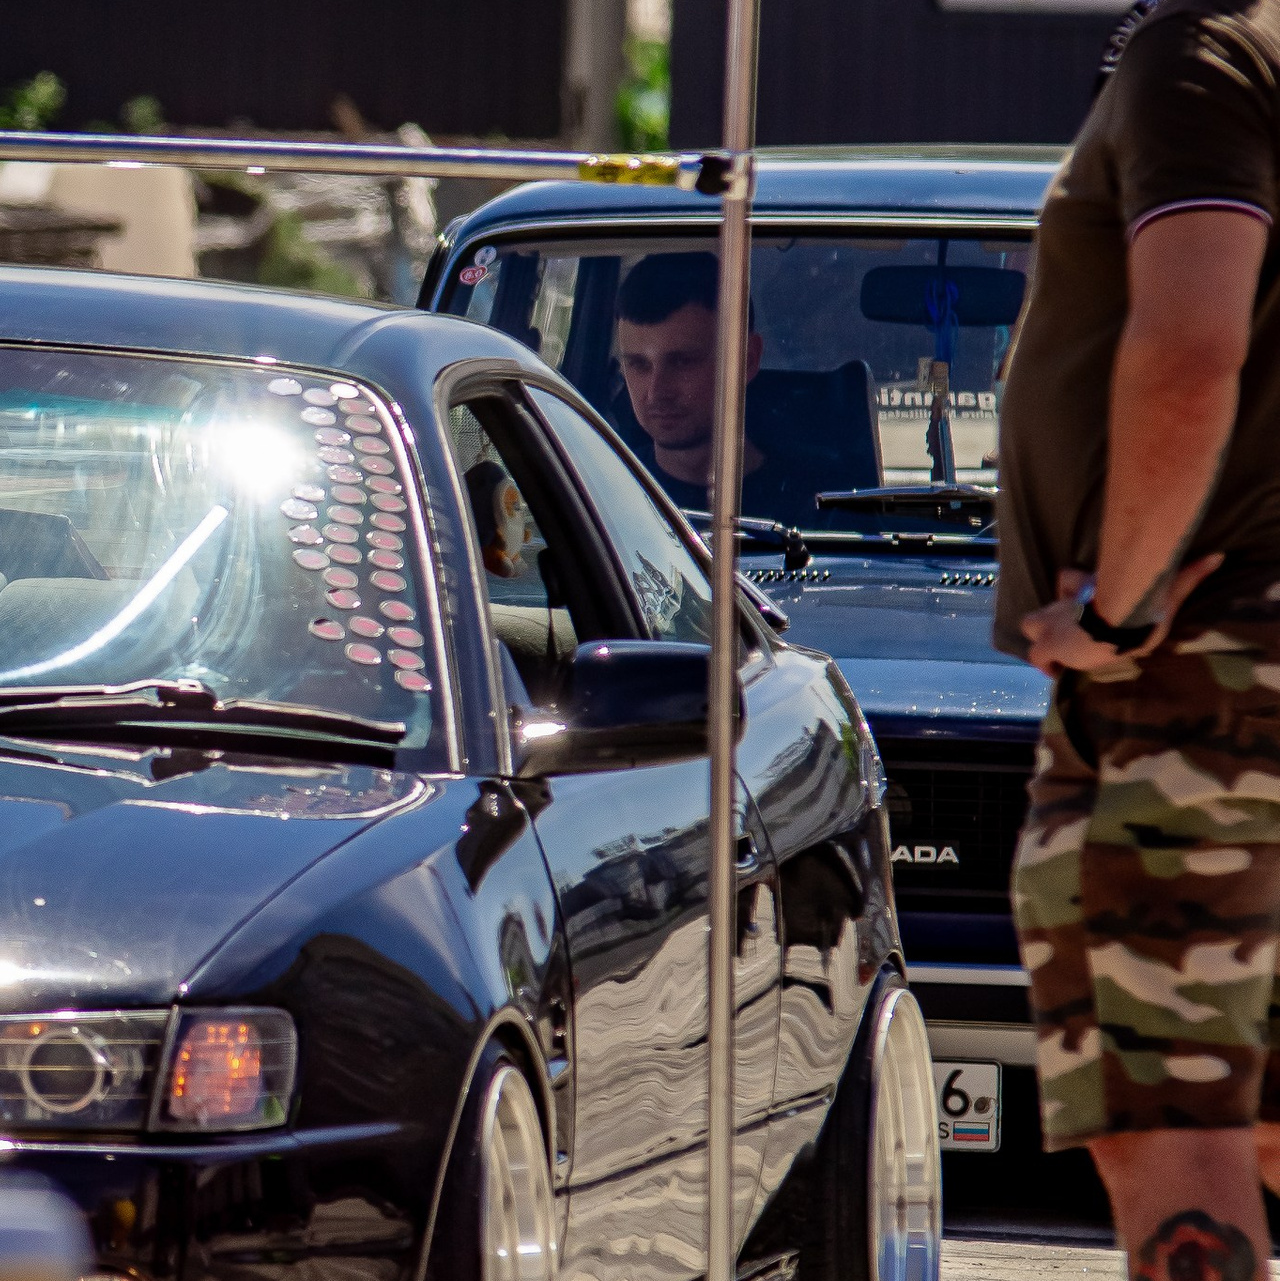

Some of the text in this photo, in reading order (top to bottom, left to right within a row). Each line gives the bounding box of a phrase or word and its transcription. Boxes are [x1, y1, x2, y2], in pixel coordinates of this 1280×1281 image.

[889, 845, 960, 864] ADA
[941, 1068, 971, 1117] 6
[938, 1121, 950, 1139] S
